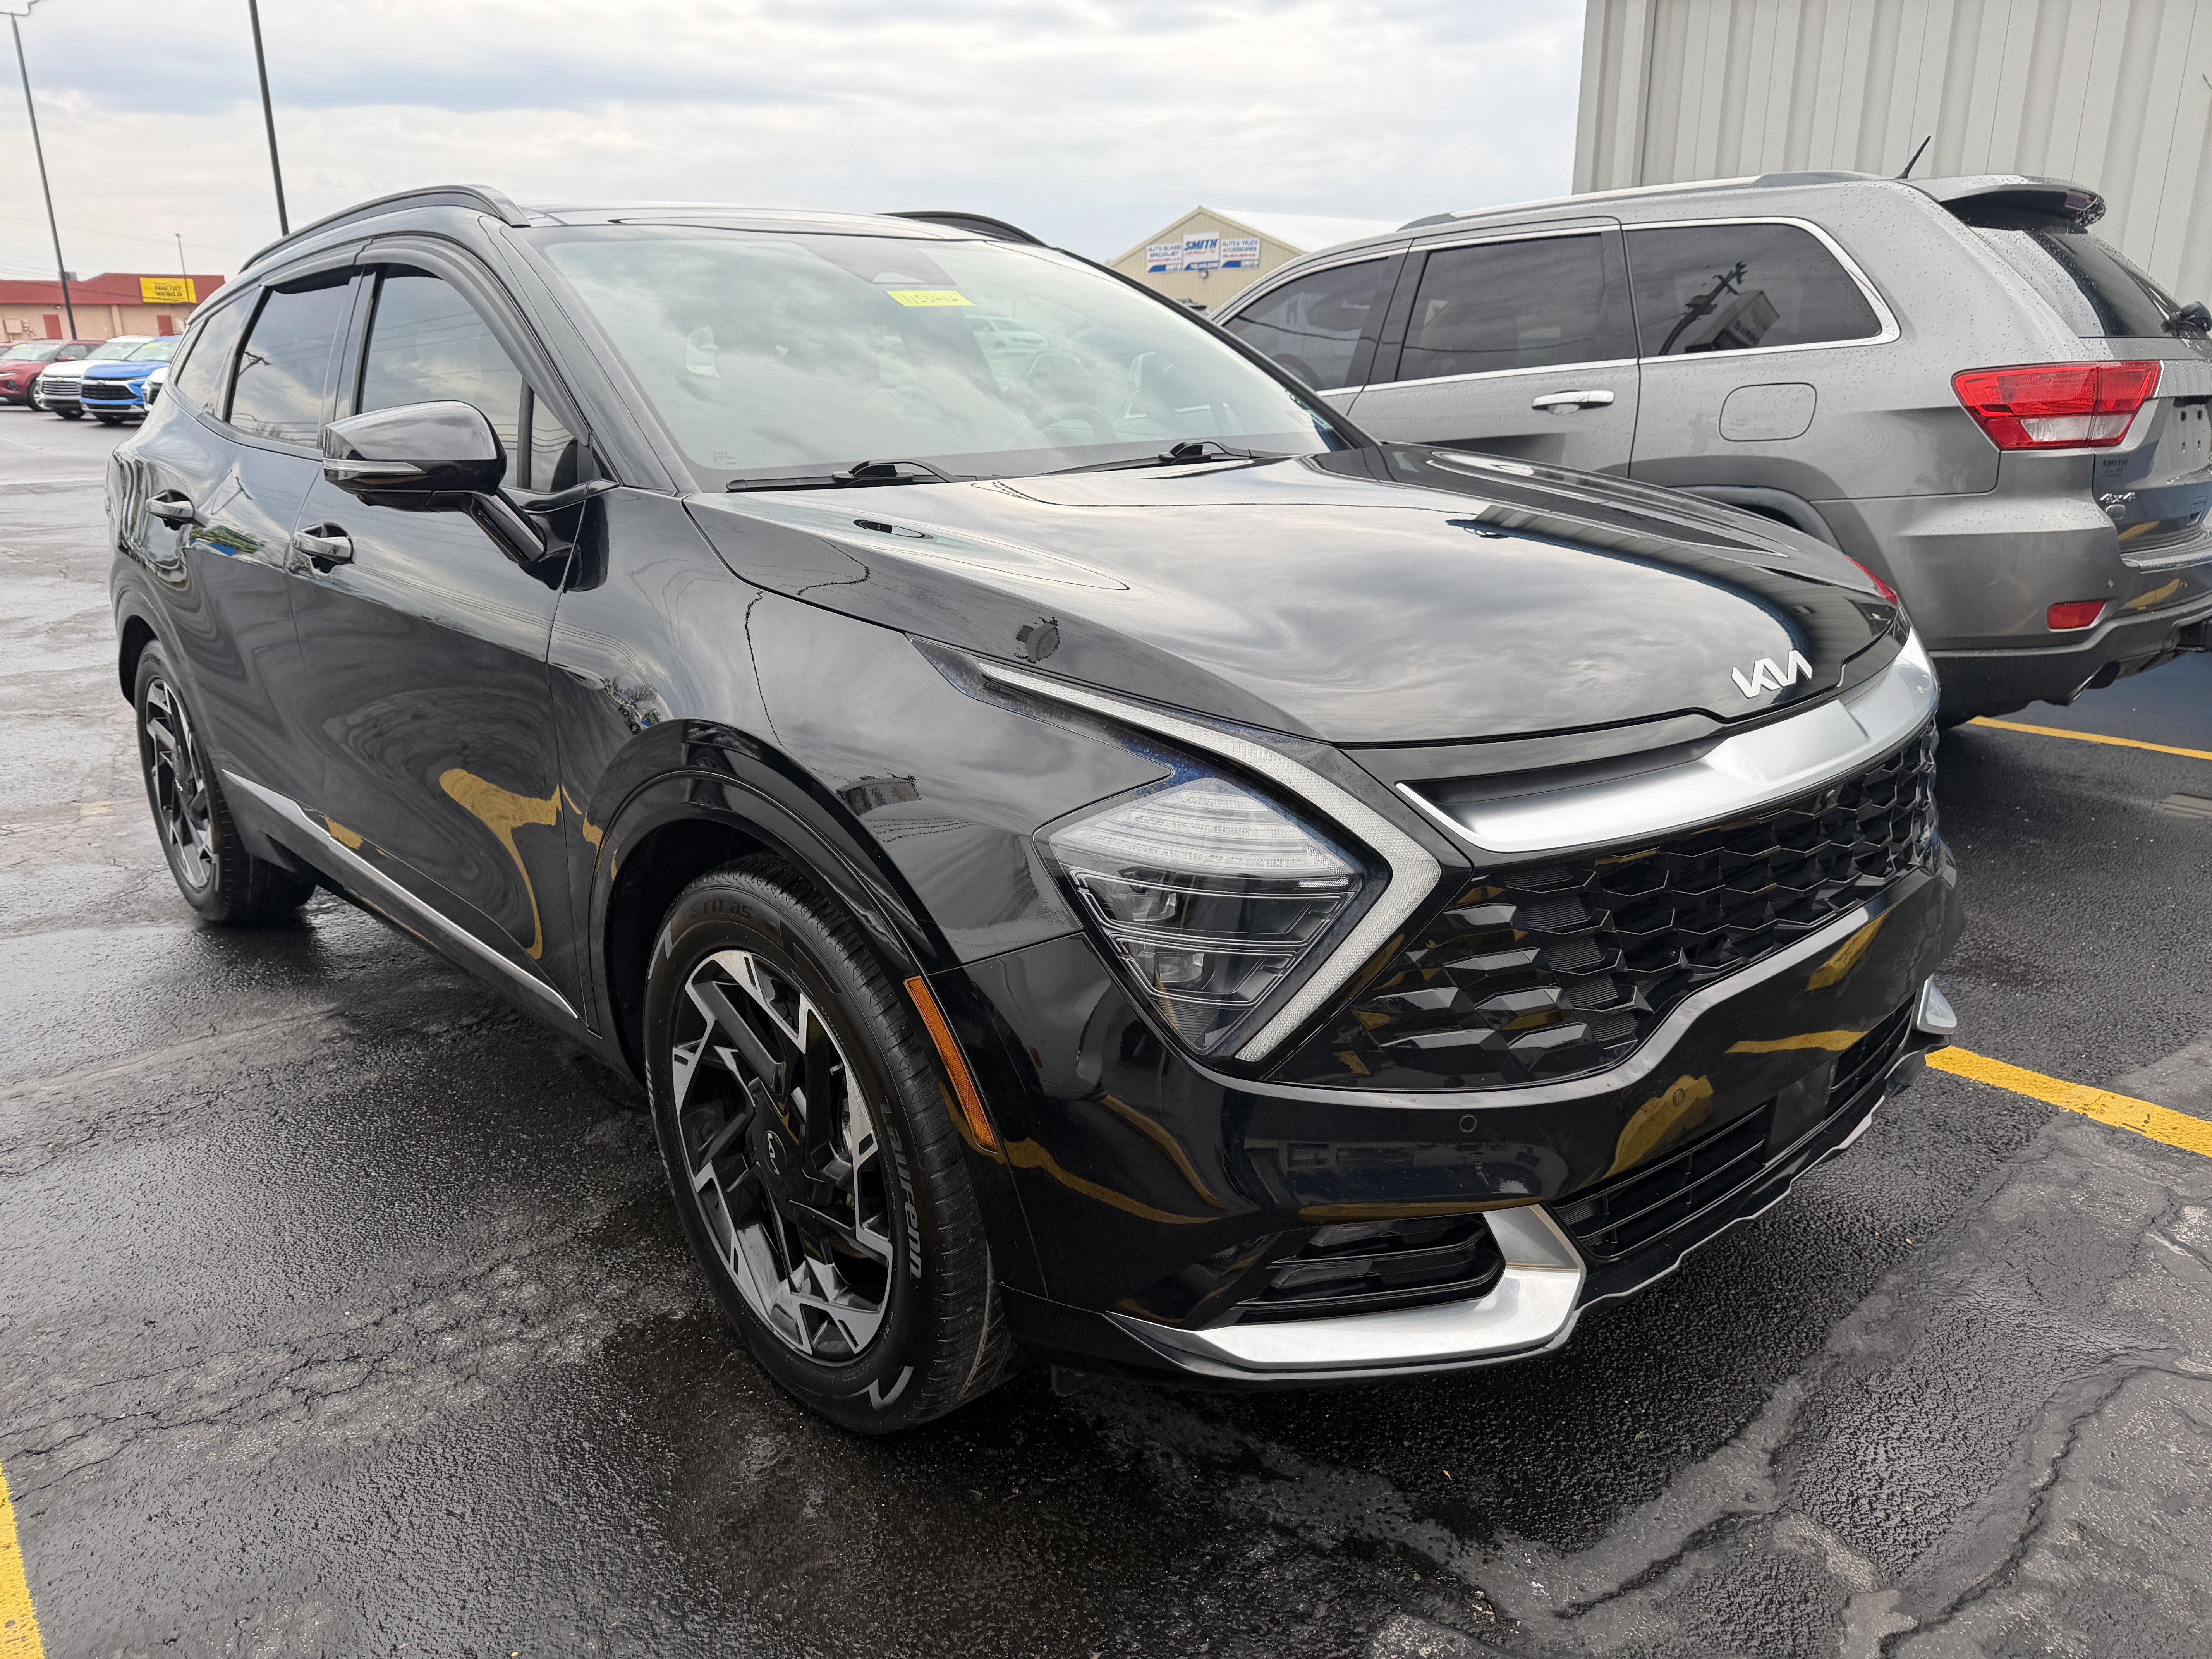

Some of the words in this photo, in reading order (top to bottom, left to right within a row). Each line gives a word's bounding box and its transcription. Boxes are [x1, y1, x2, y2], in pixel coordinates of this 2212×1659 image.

[1184, 239, 1218, 251] SMITH
[2103, 458, 2128, 467] SMITH
[2100, 492, 2135, 503] 4x4
[1731, 650, 1813, 699] KIA
[704, 900, 726, 914] FIT
